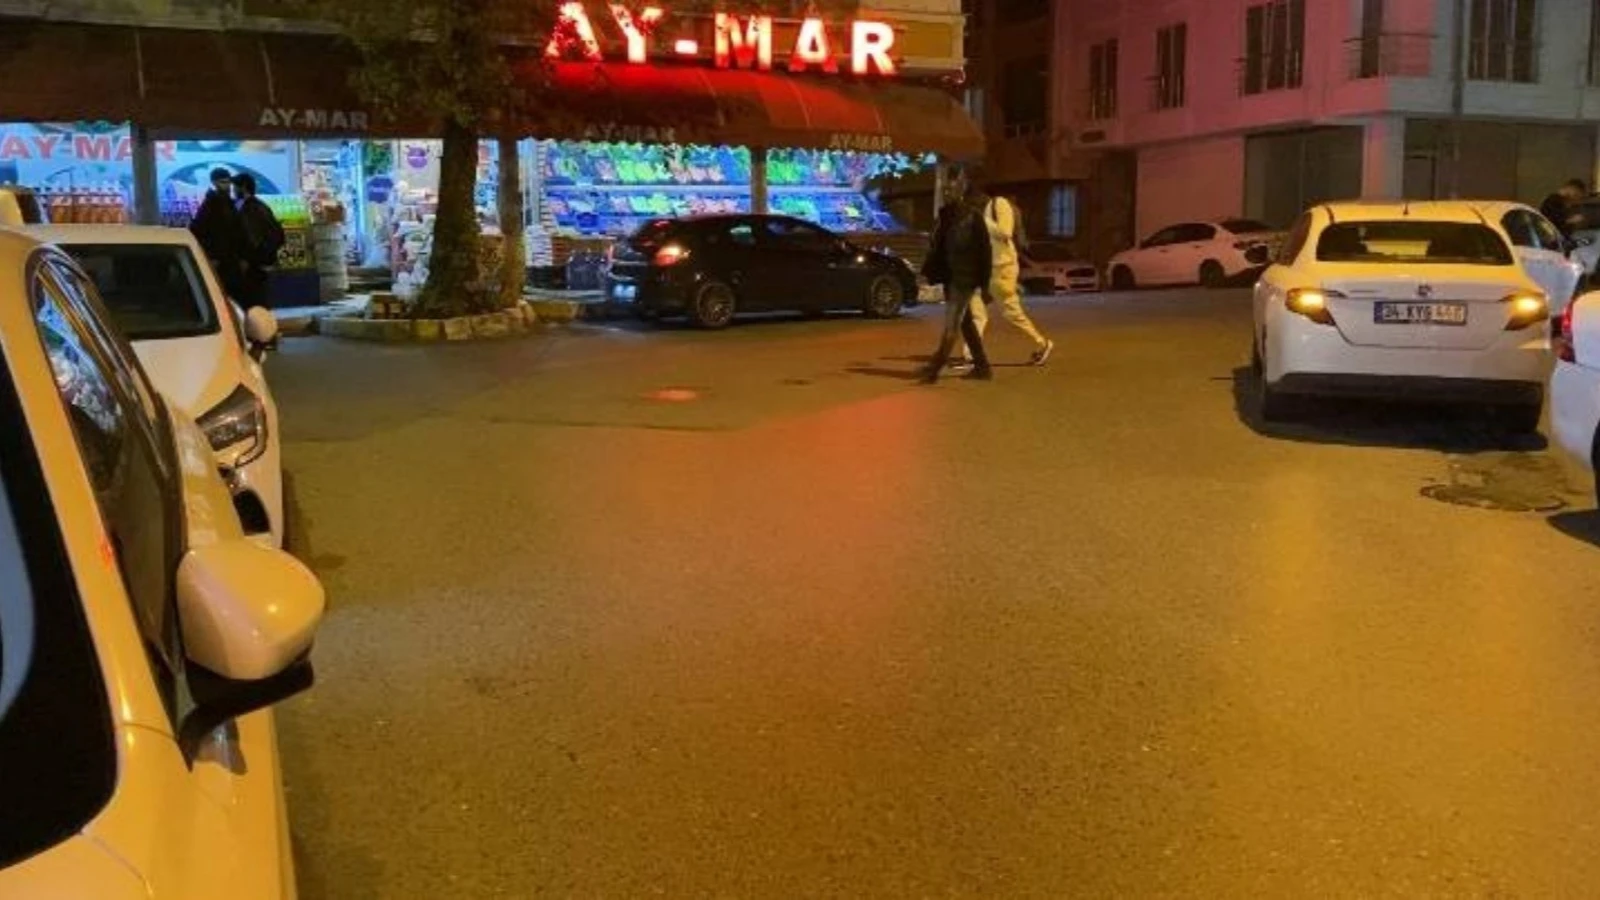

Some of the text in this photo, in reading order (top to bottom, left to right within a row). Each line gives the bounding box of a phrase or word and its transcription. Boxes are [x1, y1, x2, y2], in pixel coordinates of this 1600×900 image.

[545, 1, 896, 75] AY-MAR
[259, 109, 369, 130] AY-MAR
[828, 132, 892, 151] AY-MAR
[1383, 305, 1399, 319] 34
